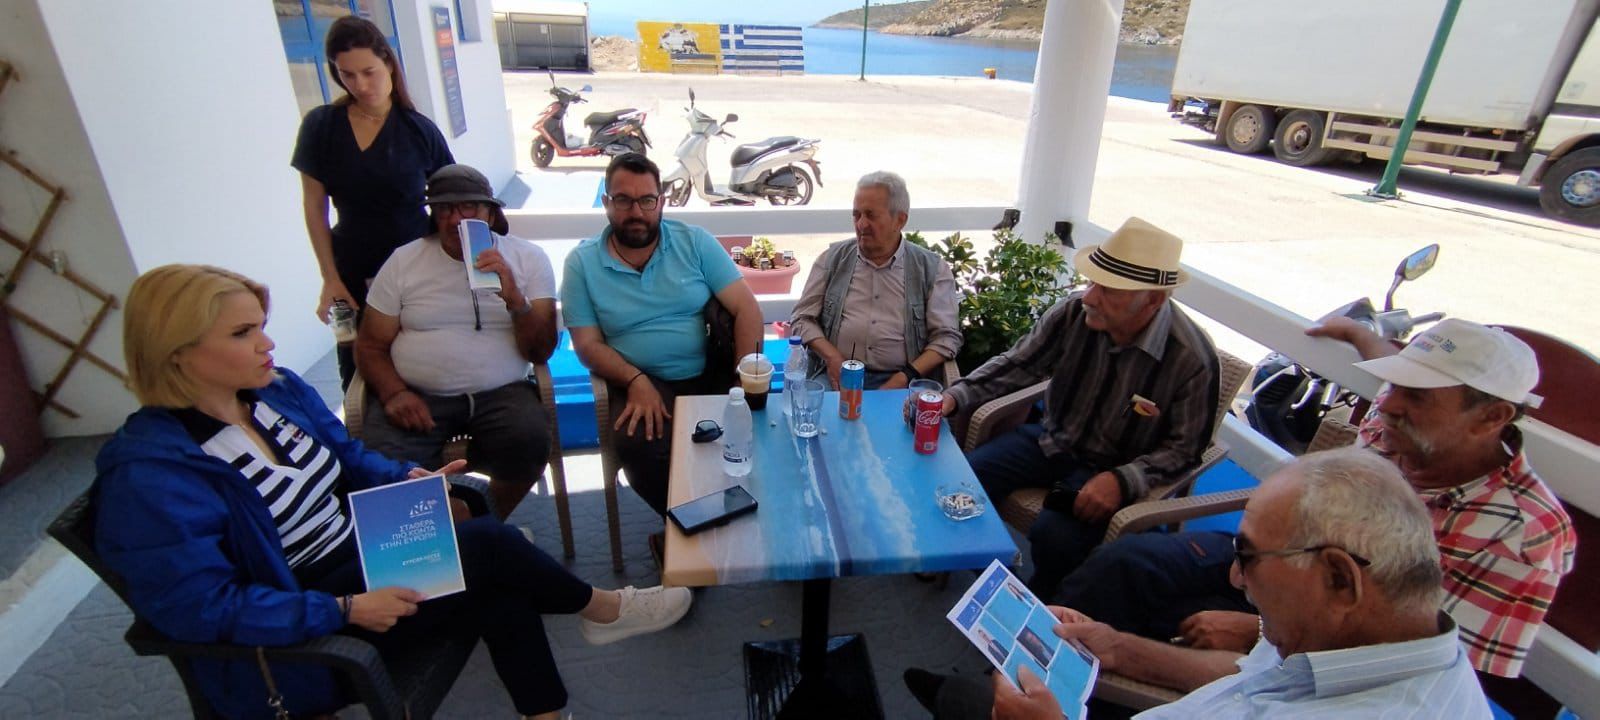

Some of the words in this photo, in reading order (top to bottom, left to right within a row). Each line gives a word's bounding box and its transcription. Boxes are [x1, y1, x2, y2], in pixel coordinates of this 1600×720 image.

[392, 531, 408, 540] ΠΙΟ
[408, 525, 436, 537] ΚΟΝΤΑ
[400, 520, 435, 532] ΣΤΑΘΕΡΑ
[380, 539, 402, 551] ΣΤΗΝ
[404, 532, 436, 545] ΕΥΡΩΠΗ
